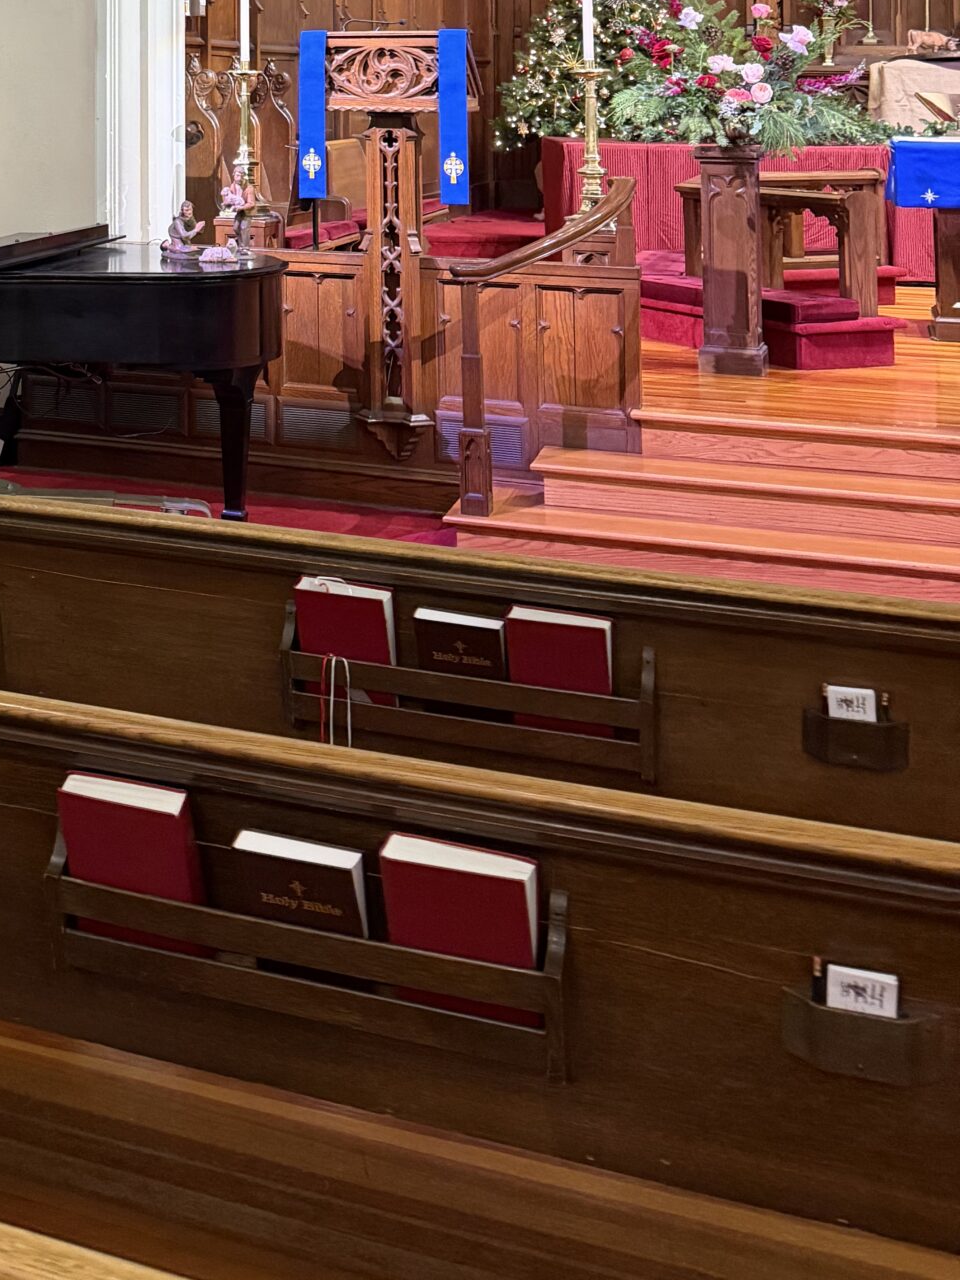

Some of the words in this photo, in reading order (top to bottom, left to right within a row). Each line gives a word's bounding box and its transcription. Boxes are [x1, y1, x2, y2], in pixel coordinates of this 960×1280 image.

[432, 651, 460, 663] Holy
[462, 655, 493, 666] Bible
[260, 892, 298, 910] Holy
[301, 900, 343, 916] Bible
